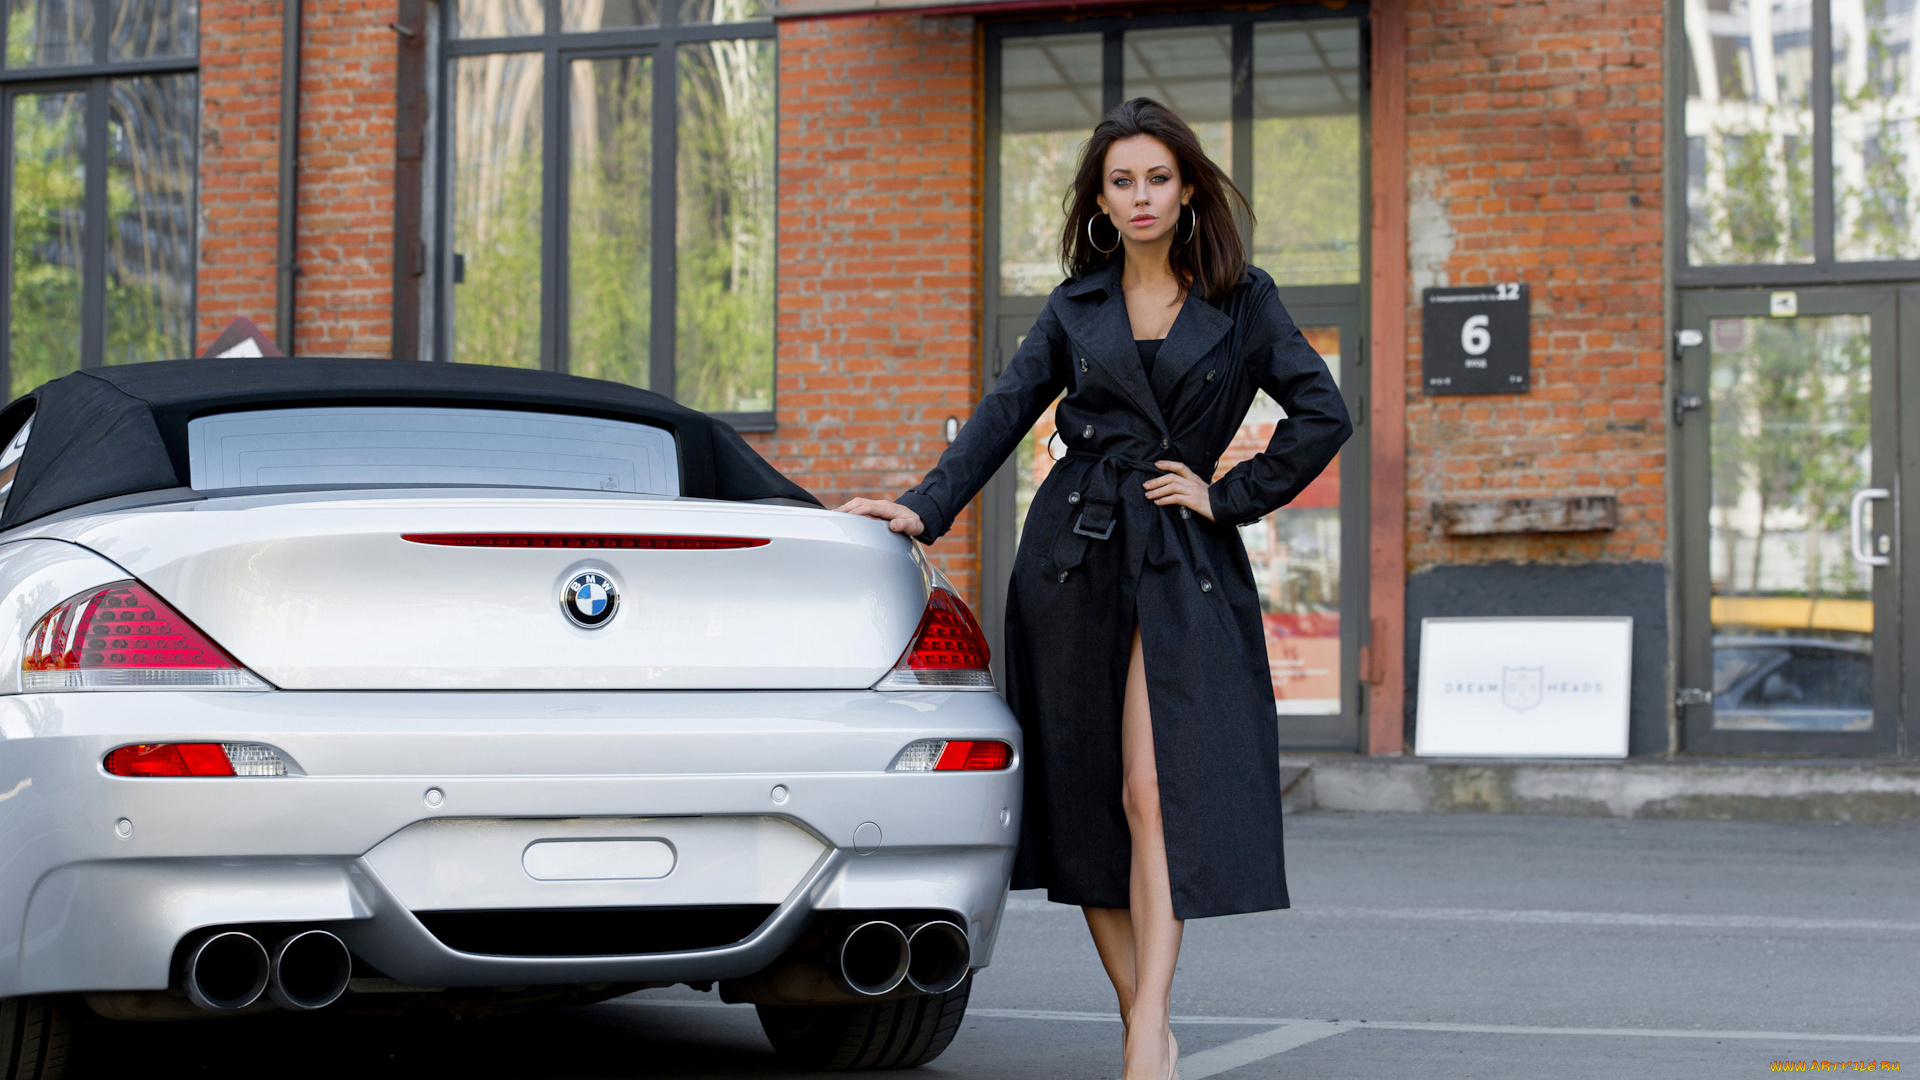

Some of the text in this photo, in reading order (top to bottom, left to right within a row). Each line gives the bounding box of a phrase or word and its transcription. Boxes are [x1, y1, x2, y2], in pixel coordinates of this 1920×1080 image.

[1496, 283, 1520, 300] 12
[1461, 314, 1491, 356] 6
[571, 575, 611, 592] BMW
[1445, 681, 1603, 693] DREAM HEADS
